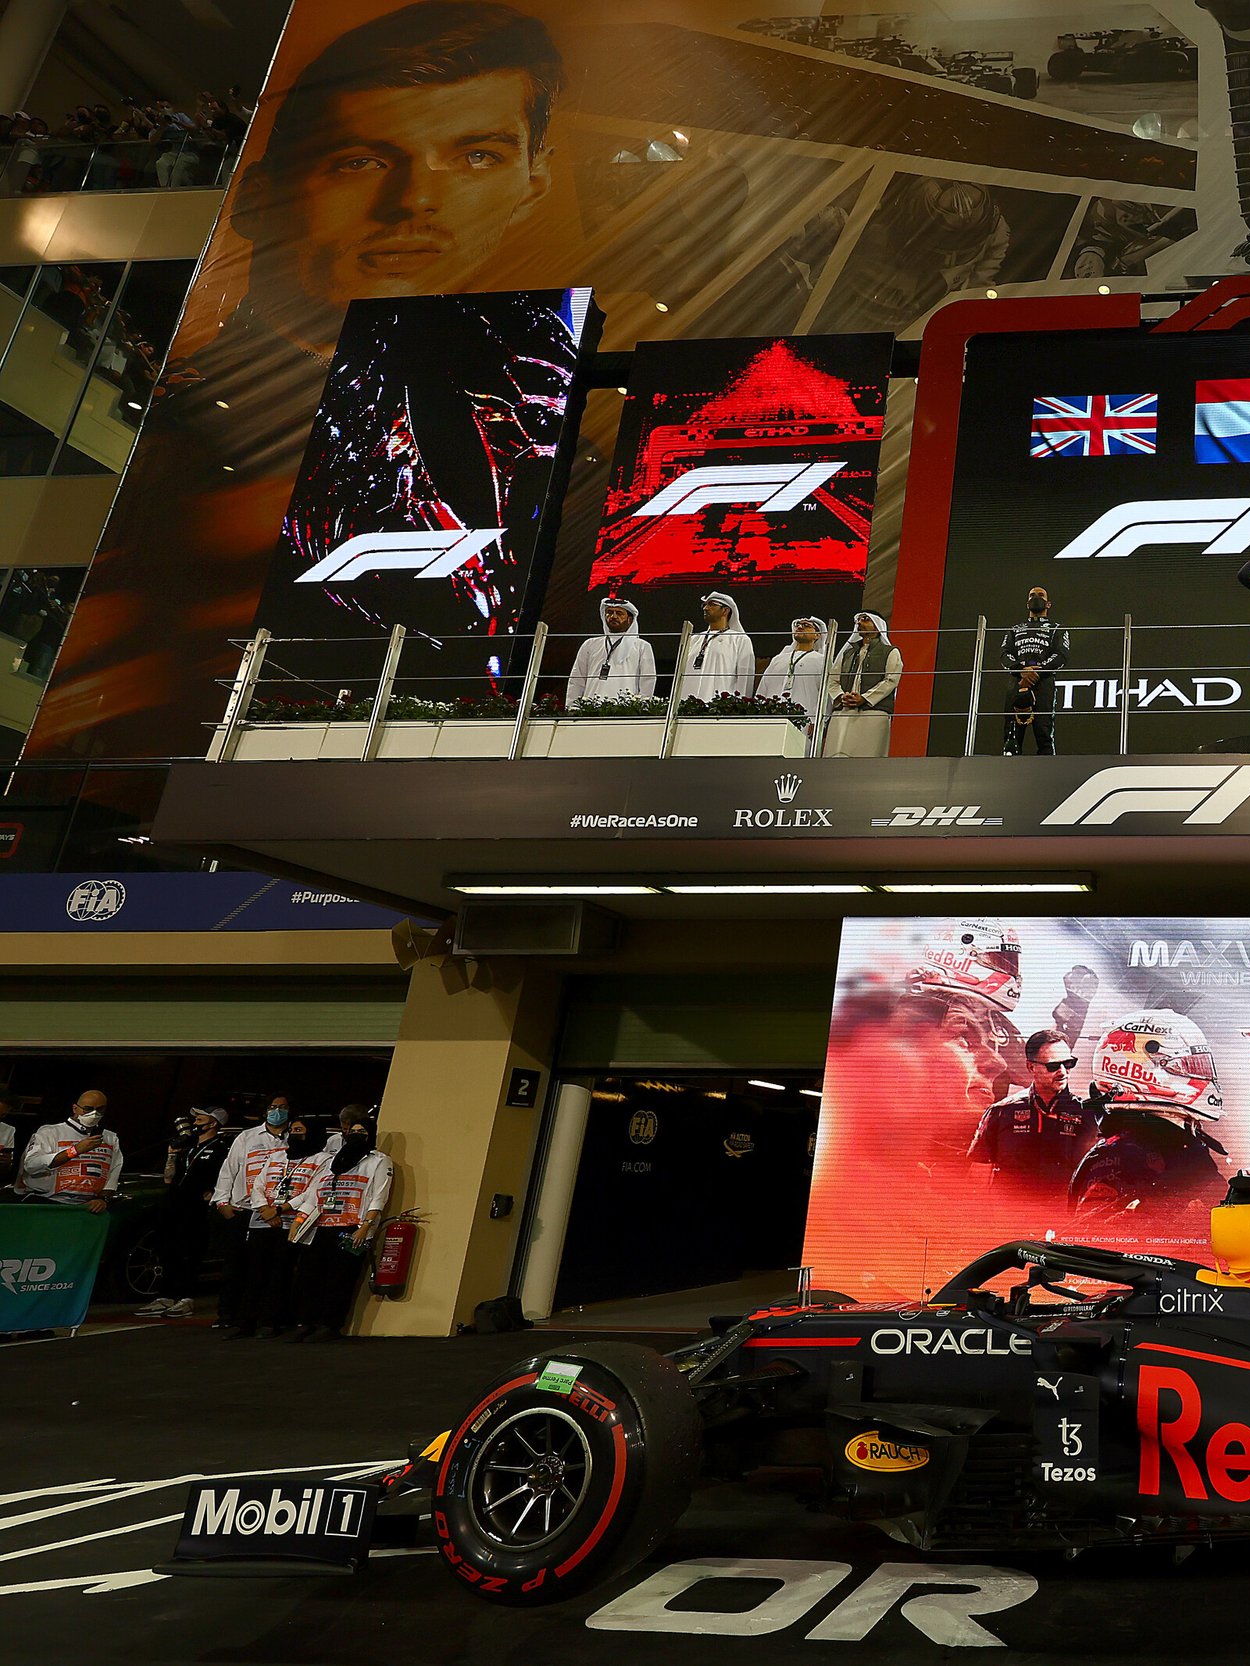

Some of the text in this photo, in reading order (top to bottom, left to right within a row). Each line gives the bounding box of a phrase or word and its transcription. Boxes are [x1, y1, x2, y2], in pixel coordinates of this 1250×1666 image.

[743, 426, 810, 438] ETIHAD
[1054, 677, 1243, 709] TIHAD
[570, 814, 698, 828] #WeRaceAsOne
[733, 809, 833, 827] ROLEX
[889, 805, 986, 826] DHL
[942, 952, 974, 973] Bull
[1102, 1056, 1161, 1085] Red Bu
[518, 1078, 530, 1096] 2
[1122, 1253, 1173, 1266] HONDA
[0, 1258, 56, 1295] RID
[20, 1282, 74, 1292] SINCE 2014
[1160, 1288, 1224, 1313] citrix
[870, 1328, 1032, 1355] ORACLE
[869, 1442, 922, 1462] RAUCH
[1041, 1462, 1096, 1482] Tezos
[191, 1488, 354, 1536] Mobil 1
